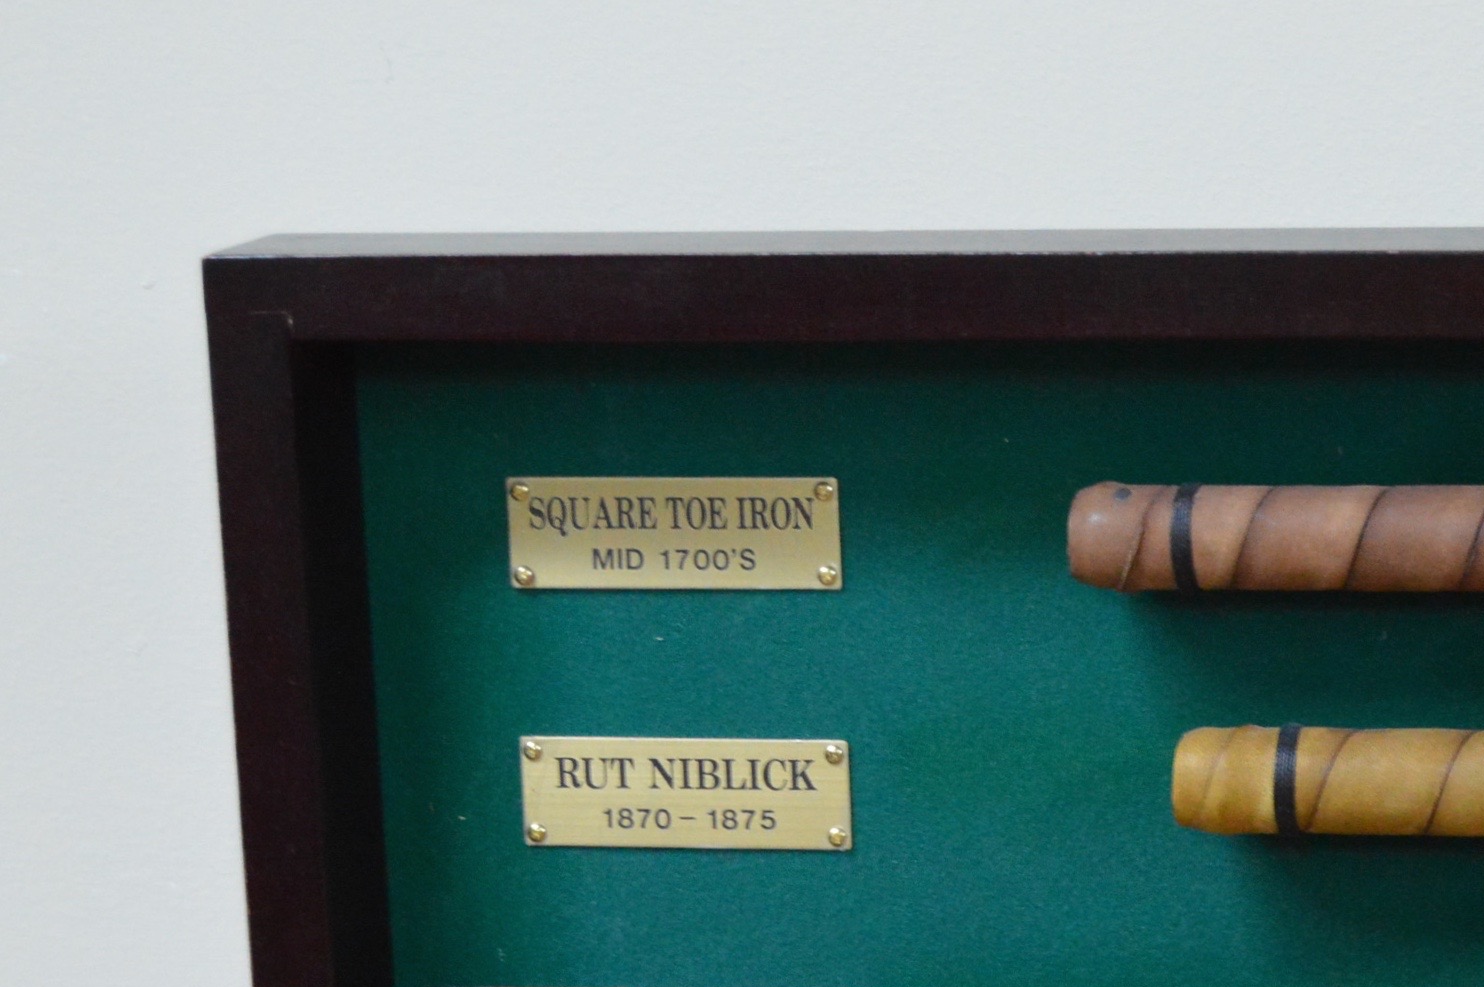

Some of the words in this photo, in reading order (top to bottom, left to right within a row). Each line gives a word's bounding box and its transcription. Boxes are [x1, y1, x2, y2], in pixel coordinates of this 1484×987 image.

[528, 496, 658, 537] SQUARE
[665, 496, 730, 531] TOE
[736, 496, 815, 531] IRON
[592, 547, 645, 571] MID
[660, 548, 757, 571] 1700'S
[554, 756, 636, 790] RUT
[648, 757, 819, 792] NIBLICK
[602, 808, 673, 830] 1870
[706, 808, 778, 831] 1875
